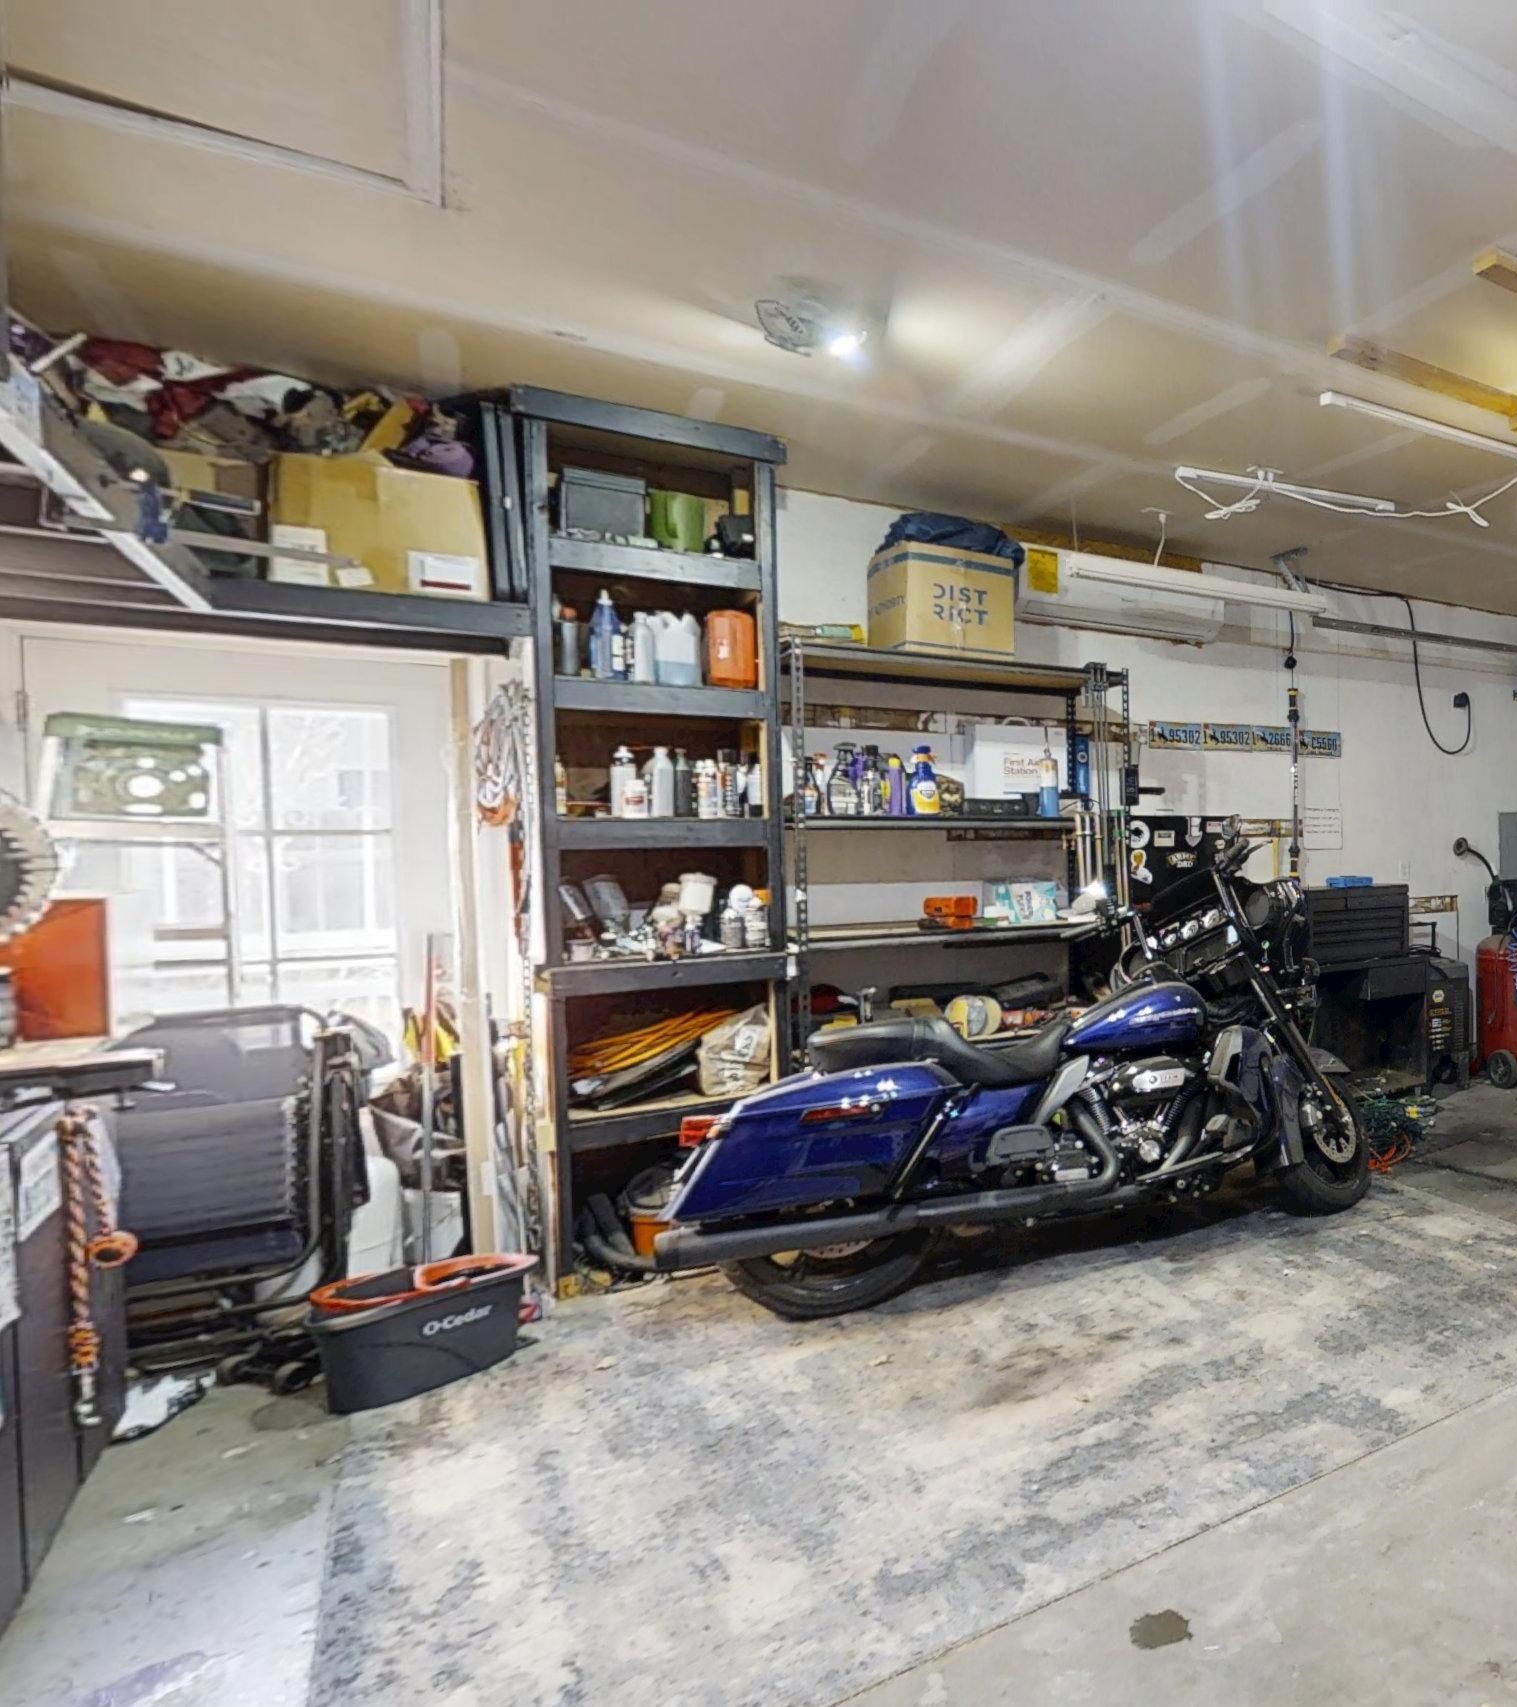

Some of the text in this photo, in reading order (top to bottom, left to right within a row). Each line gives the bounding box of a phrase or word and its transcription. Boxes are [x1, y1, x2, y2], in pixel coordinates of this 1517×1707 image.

[933, 583, 987, 605] DIST
[933, 603, 988, 626] RICT
[1004, 766, 1038, 775] Station
